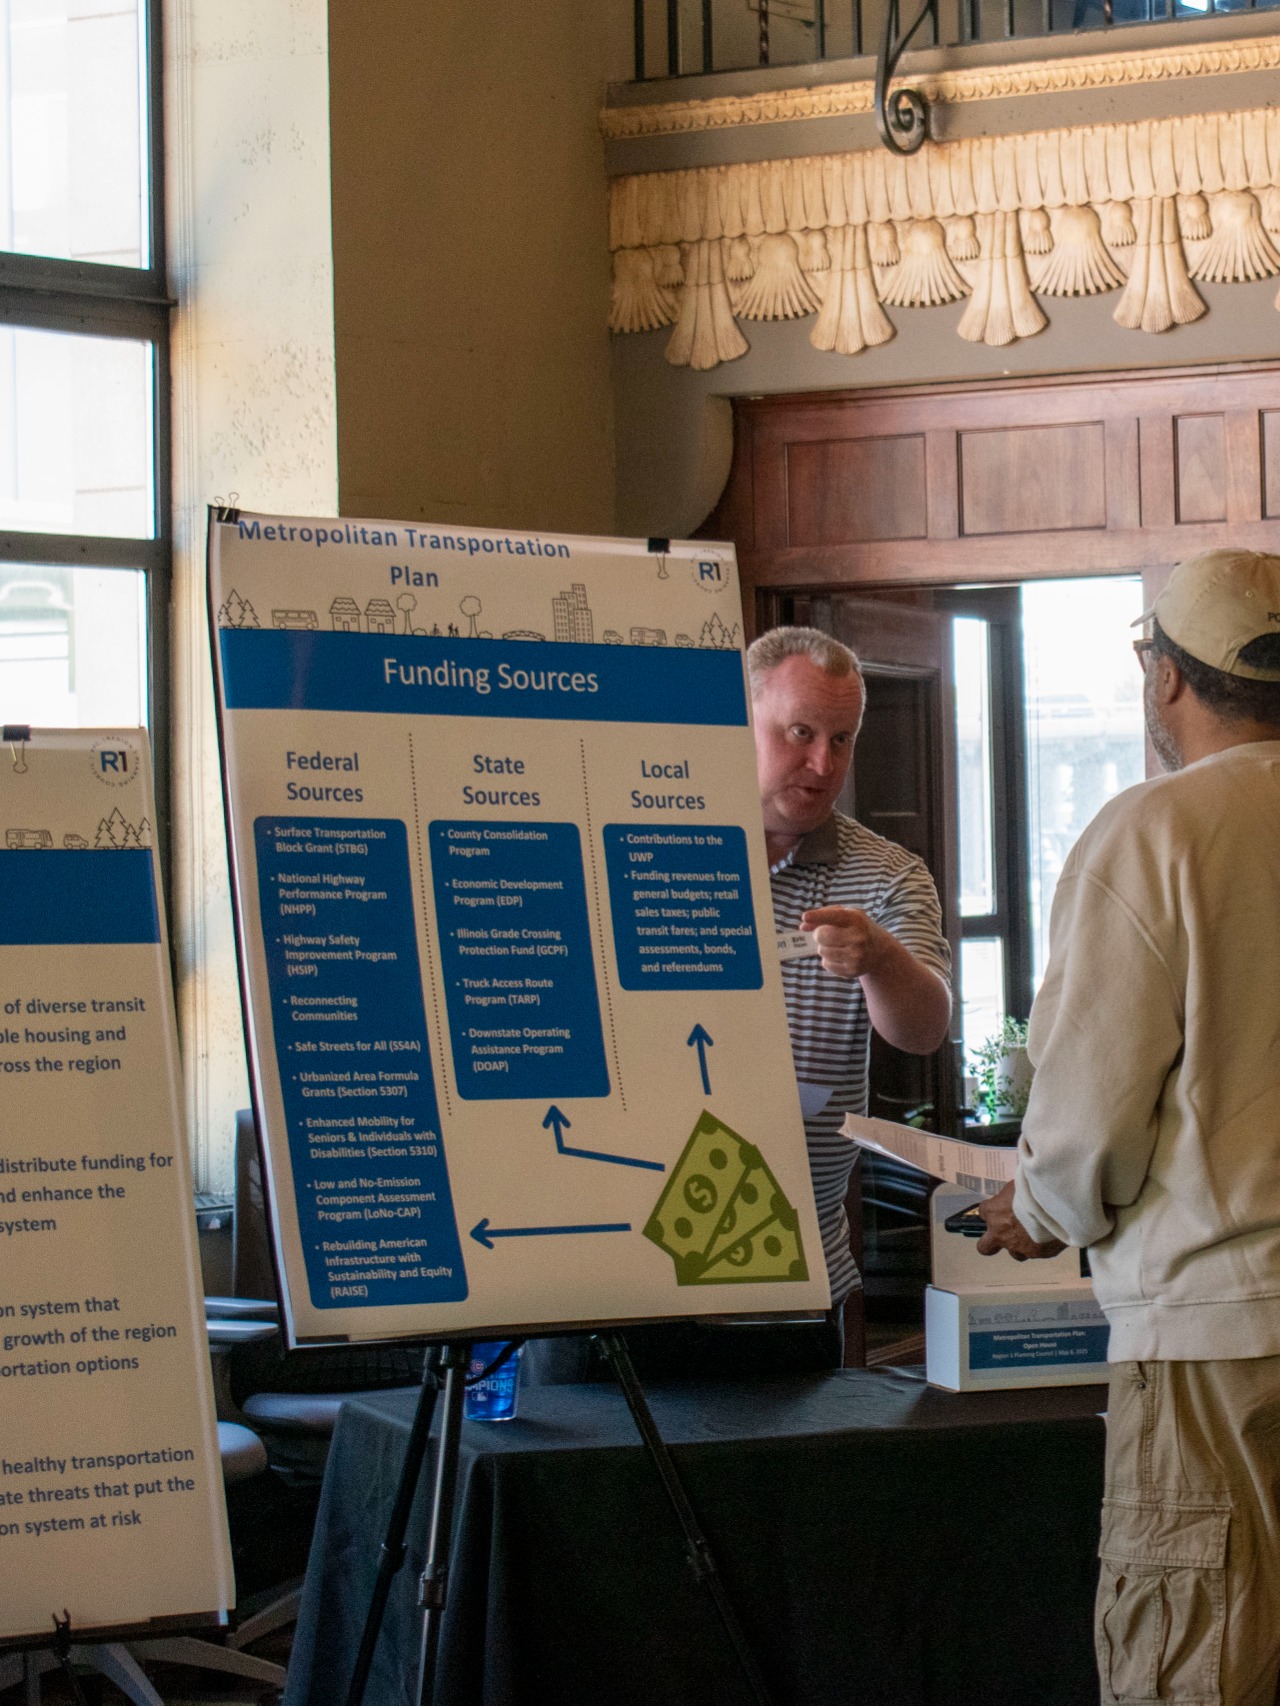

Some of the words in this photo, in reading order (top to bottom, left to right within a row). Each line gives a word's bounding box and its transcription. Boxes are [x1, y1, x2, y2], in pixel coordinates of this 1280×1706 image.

[239, 520, 398, 548] Metropolitan
[405, 529, 570, 558] Transportation
[390, 565, 438, 587] Plan
[699, 562, 721, 581] R1
[384, 658, 491, 694] Funding
[497, 663, 598, 692] Sources
[101, 751, 128, 772] R1
[286, 750, 359, 771] Federal
[473, 754, 524, 774] State
[641, 760, 689, 779] Local
[286, 782, 363, 802] Sources
[462, 785, 540, 806] Sources
[631, 790, 705, 810] Sources
[274, 826, 312, 837] Surface
[314, 827, 386, 840] Transportation
[447, 829, 481, 841] County
[483, 829, 548, 840] Consolidation
[626, 833, 692, 844] Contributions
[693, 835, 705, 845] to
[706, 834, 722, 845] the
[275, 842, 303, 852] Block
[305, 842, 333, 853] Grant
[335, 843, 368, 855] (STBG)
[449, 845, 490, 857] Program
[628, 852, 653, 862] UWP
[452, 878, 498, 889] Economic
[499, 879, 563, 891] Development
[453, 895, 495, 907] Program
[496, 895, 522, 907] (EDP)
[641, 961, 660, 972] and
[661, 961, 723, 972] referendums
[462, 978, 490, 988] Truck
[492, 978, 523, 988] Access
[524, 978, 553, 988] Route
[4, 998, 21, 1014] of
[26, 998, 86, 1014] diverse
[90, 997, 145, 1012] transit
[290, 995, 358, 1007] Reconnecting
[292, 1010, 358, 1021] Communities
[24, 1027, 91, 1045] housing
[95, 1025, 126, 1041] and
[295, 1041, 317, 1051] Safe
[319, 1041, 354, 1051] Streets
[356, 1040, 371, 1051] for
[373, 1040, 387, 1050] All
[389, 1040, 420, 1052] (SS4A)
[34, 1056, 63, 1072] the
[68, 1055, 121, 1074] region
[81, 1154, 146, 1171] funding
[149, 1152, 173, 1167] for
[21, 1186, 93, 1202] enhance
[97, 1183, 125, 1199] the
[20, 1301, 80, 1319] system
[84, 1297, 120, 1312] that
[3, 1328, 65, 1350] growth
[70, 1326, 87, 1343] of
[91, 1326, 119, 1341] the
[125, 1323, 176, 1342] region
[75, 1355, 139, 1375] options
[2, 1456, 66, 1475] healthy
[71, 1449, 194, 1470] transportation
[27, 1486, 90, 1503] threats
[93, 1481, 129, 1498] that
[134, 1479, 163, 1498] put
[166, 1476, 194, 1492] the
[24, 1518, 84, 1536] system
[90, 1514, 107, 1528] at
[111, 1509, 141, 1526] risk
